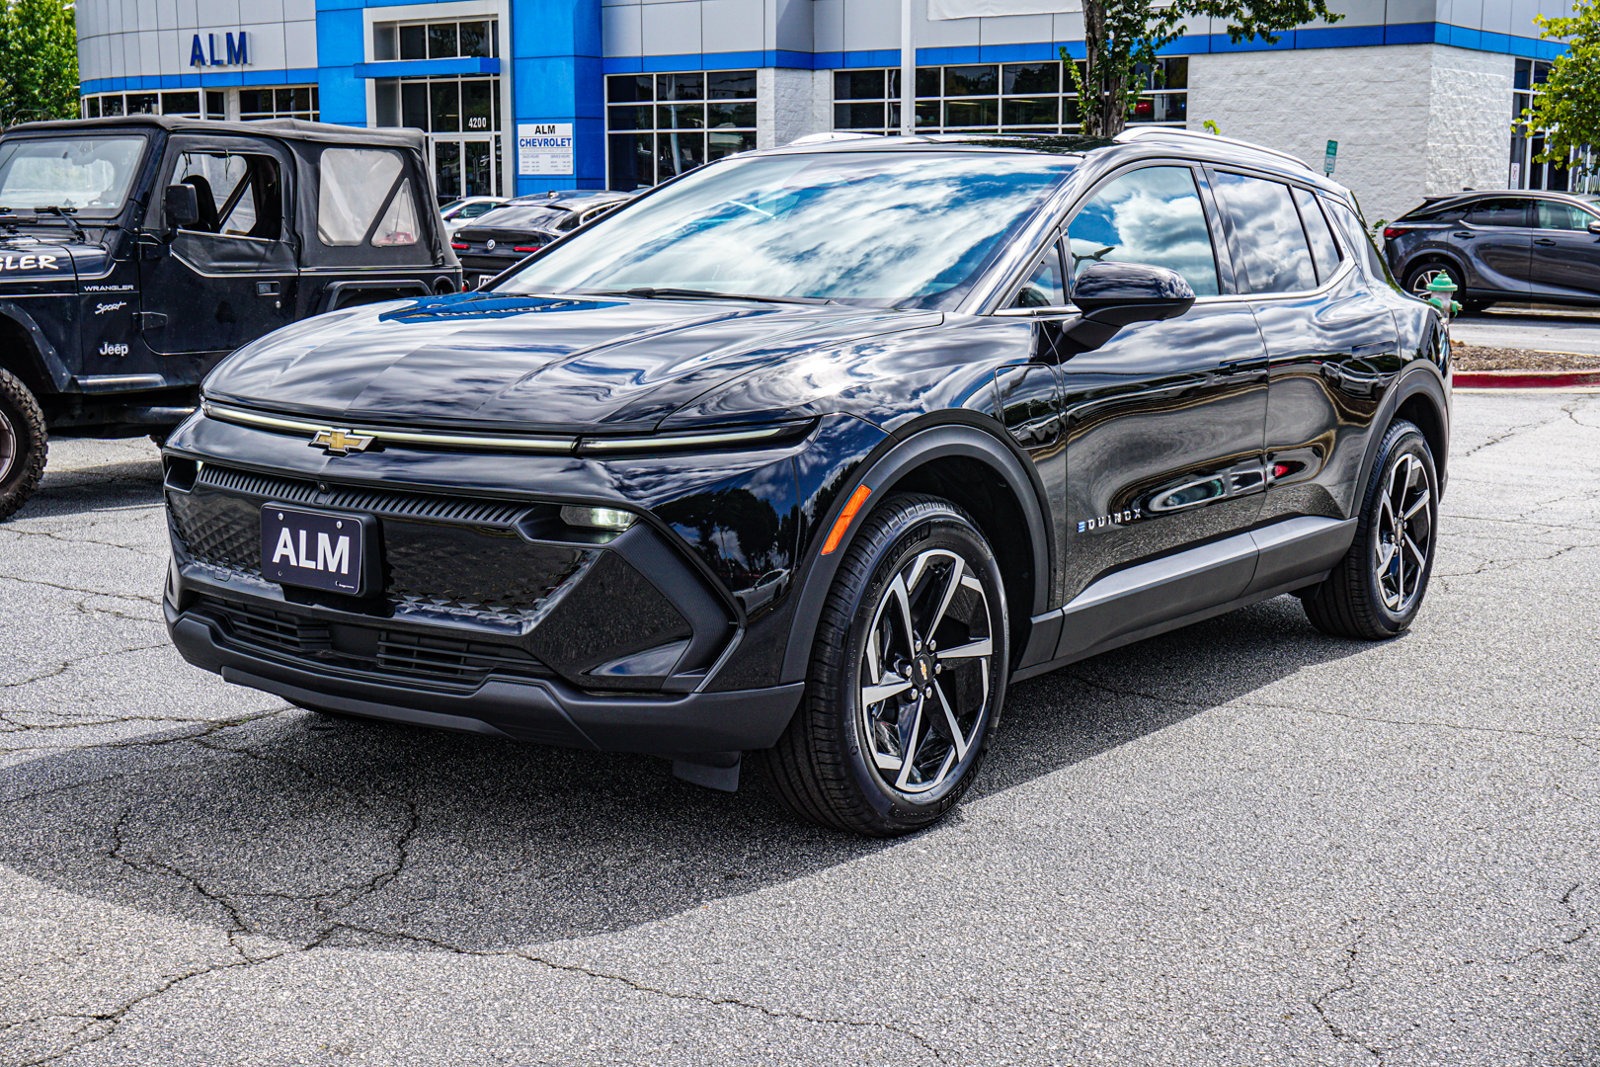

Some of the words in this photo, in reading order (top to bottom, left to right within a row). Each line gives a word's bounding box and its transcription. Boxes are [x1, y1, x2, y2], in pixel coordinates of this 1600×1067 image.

[190, 32, 248, 66] ALM
[468, 117, 487, 128] 4200
[535, 125, 556, 135] ALM
[519, 138, 572, 147] CHEVROLET
[0, 255, 59, 271] LER
[84, 284, 134, 292] WRANGLER
[99, 342, 129, 357] Jeep
[1077, 508, 1141, 533] EQUINOX
[272, 527, 350, 575] ALM
